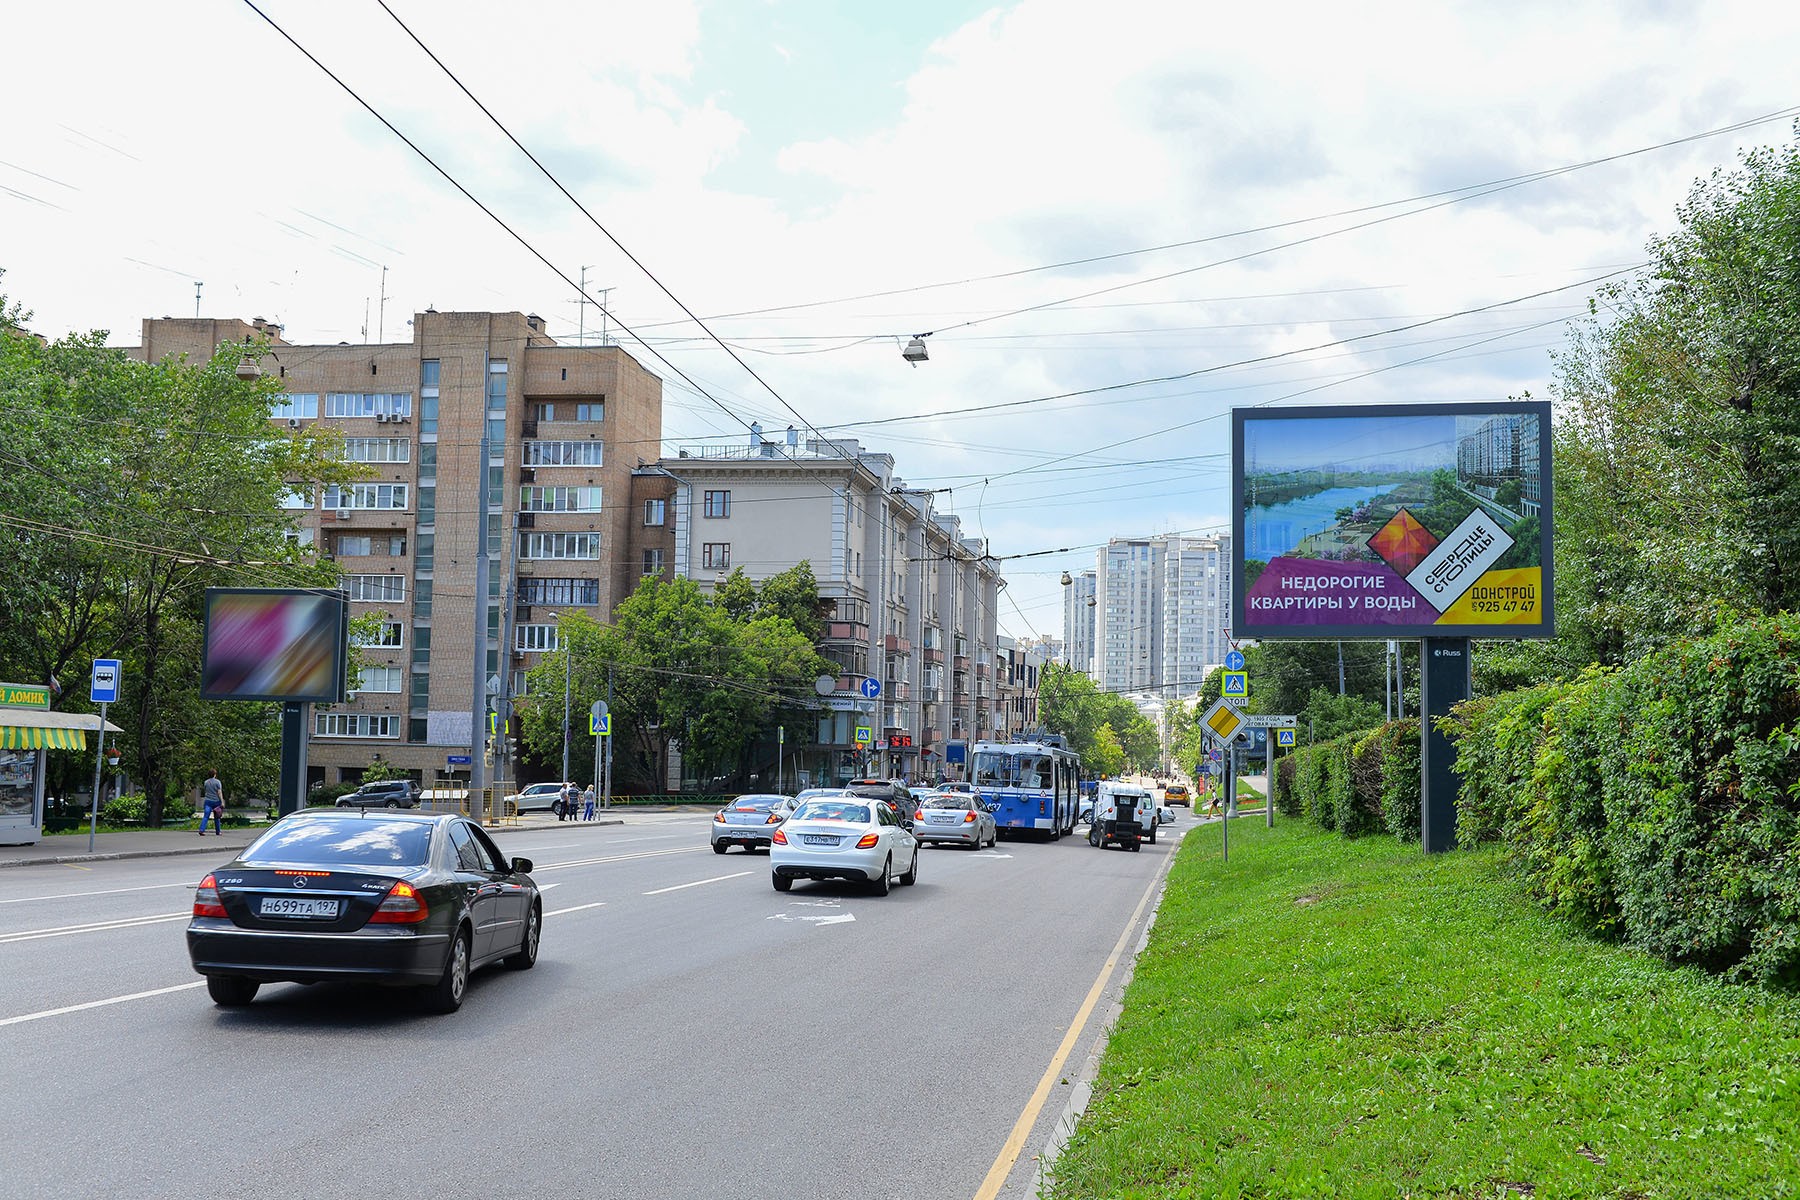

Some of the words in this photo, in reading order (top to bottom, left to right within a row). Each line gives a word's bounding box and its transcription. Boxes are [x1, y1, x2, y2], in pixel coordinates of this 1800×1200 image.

[1424, 525, 1487, 585] СЕРДЦЕ
[1433, 533, 1496, 593] СТОЛИЦЫ
[1281, 576, 1385, 591] НЕДОРОГИЕ
[1471, 584, 1535, 600] ДОНСТРОЙ
[1251, 597, 1343, 610] КВАРТИРЫ
[1348, 596, 1359, 609] У
[1364, 596, 1416, 611] ВОДЫ
[1478, 601, 1500, 612] 925
[1503, 601, 1517, 612] 47
[1520, 601, 1535, 612] 47
[1442, 649, 1461, 657] Russ
[8, 690, 45, 704] ДОМИК
[317, 901, 335, 911] 197
